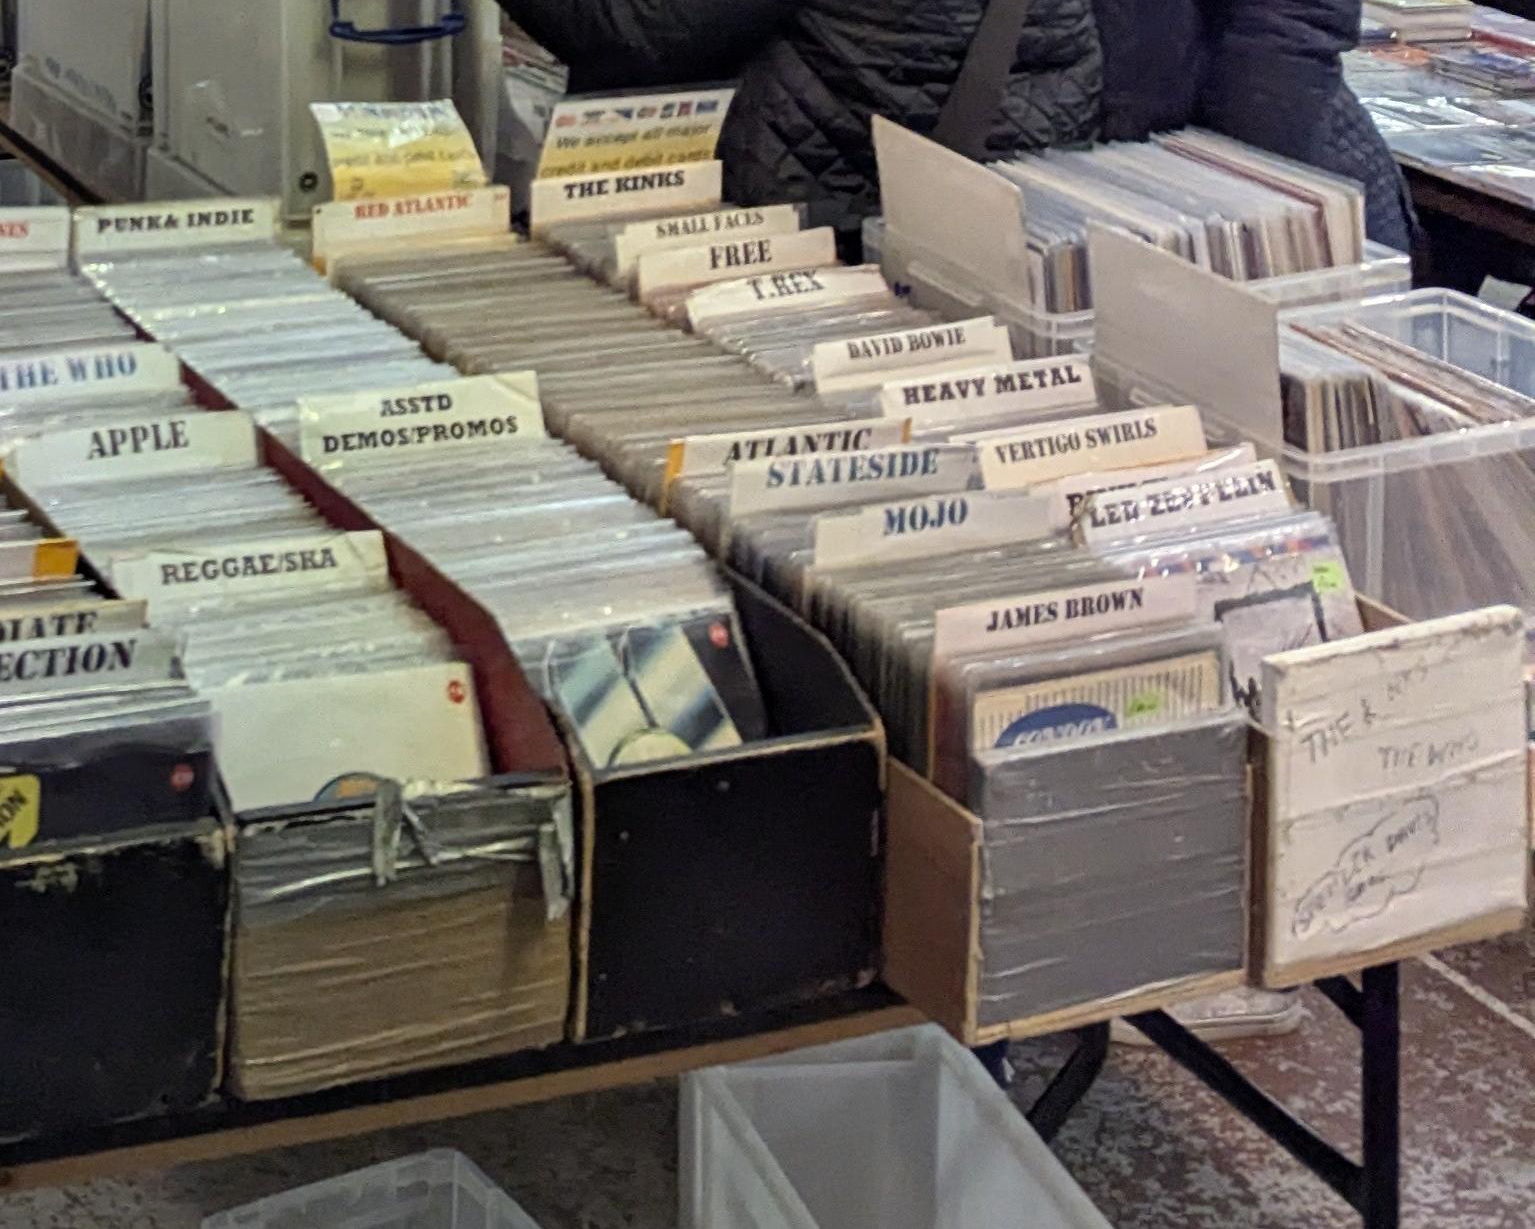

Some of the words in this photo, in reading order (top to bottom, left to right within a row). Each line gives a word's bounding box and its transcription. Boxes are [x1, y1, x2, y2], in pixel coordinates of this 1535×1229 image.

[564, 179, 610, 199] THE
[615, 170, 685, 193] KINKS
[187, 208, 255, 227] INDIE
[354, 202, 390, 219] RED
[655, 214, 708, 239] SMALL
[713, 209, 765, 232] FACES
[709, 238, 773, 270] FREE
[847, 335, 903, 360] DAVID
[908, 326, 966, 352] BOWIE
[64, 351, 137, 382] WHO
[902, 373, 985, 406] HEAVY
[994, 365, 1082, 394] METAL
[380, 393, 453, 418] ASSTD
[86, 419, 190, 460] APPLE
[724, 428, 872, 466] ATLANTIC
[994, 431, 1081, 466] VERTIGO
[1085, 417, 1158, 451] SWIRLS
[766, 448, 940, 489] STATESIDE
[883, 498, 969, 537] MOJO
[161, 547, 337, 585] REGGAE/SKA
[986, 601, 1059, 632] JAMES
[1065, 587, 1144, 620] BROWN
